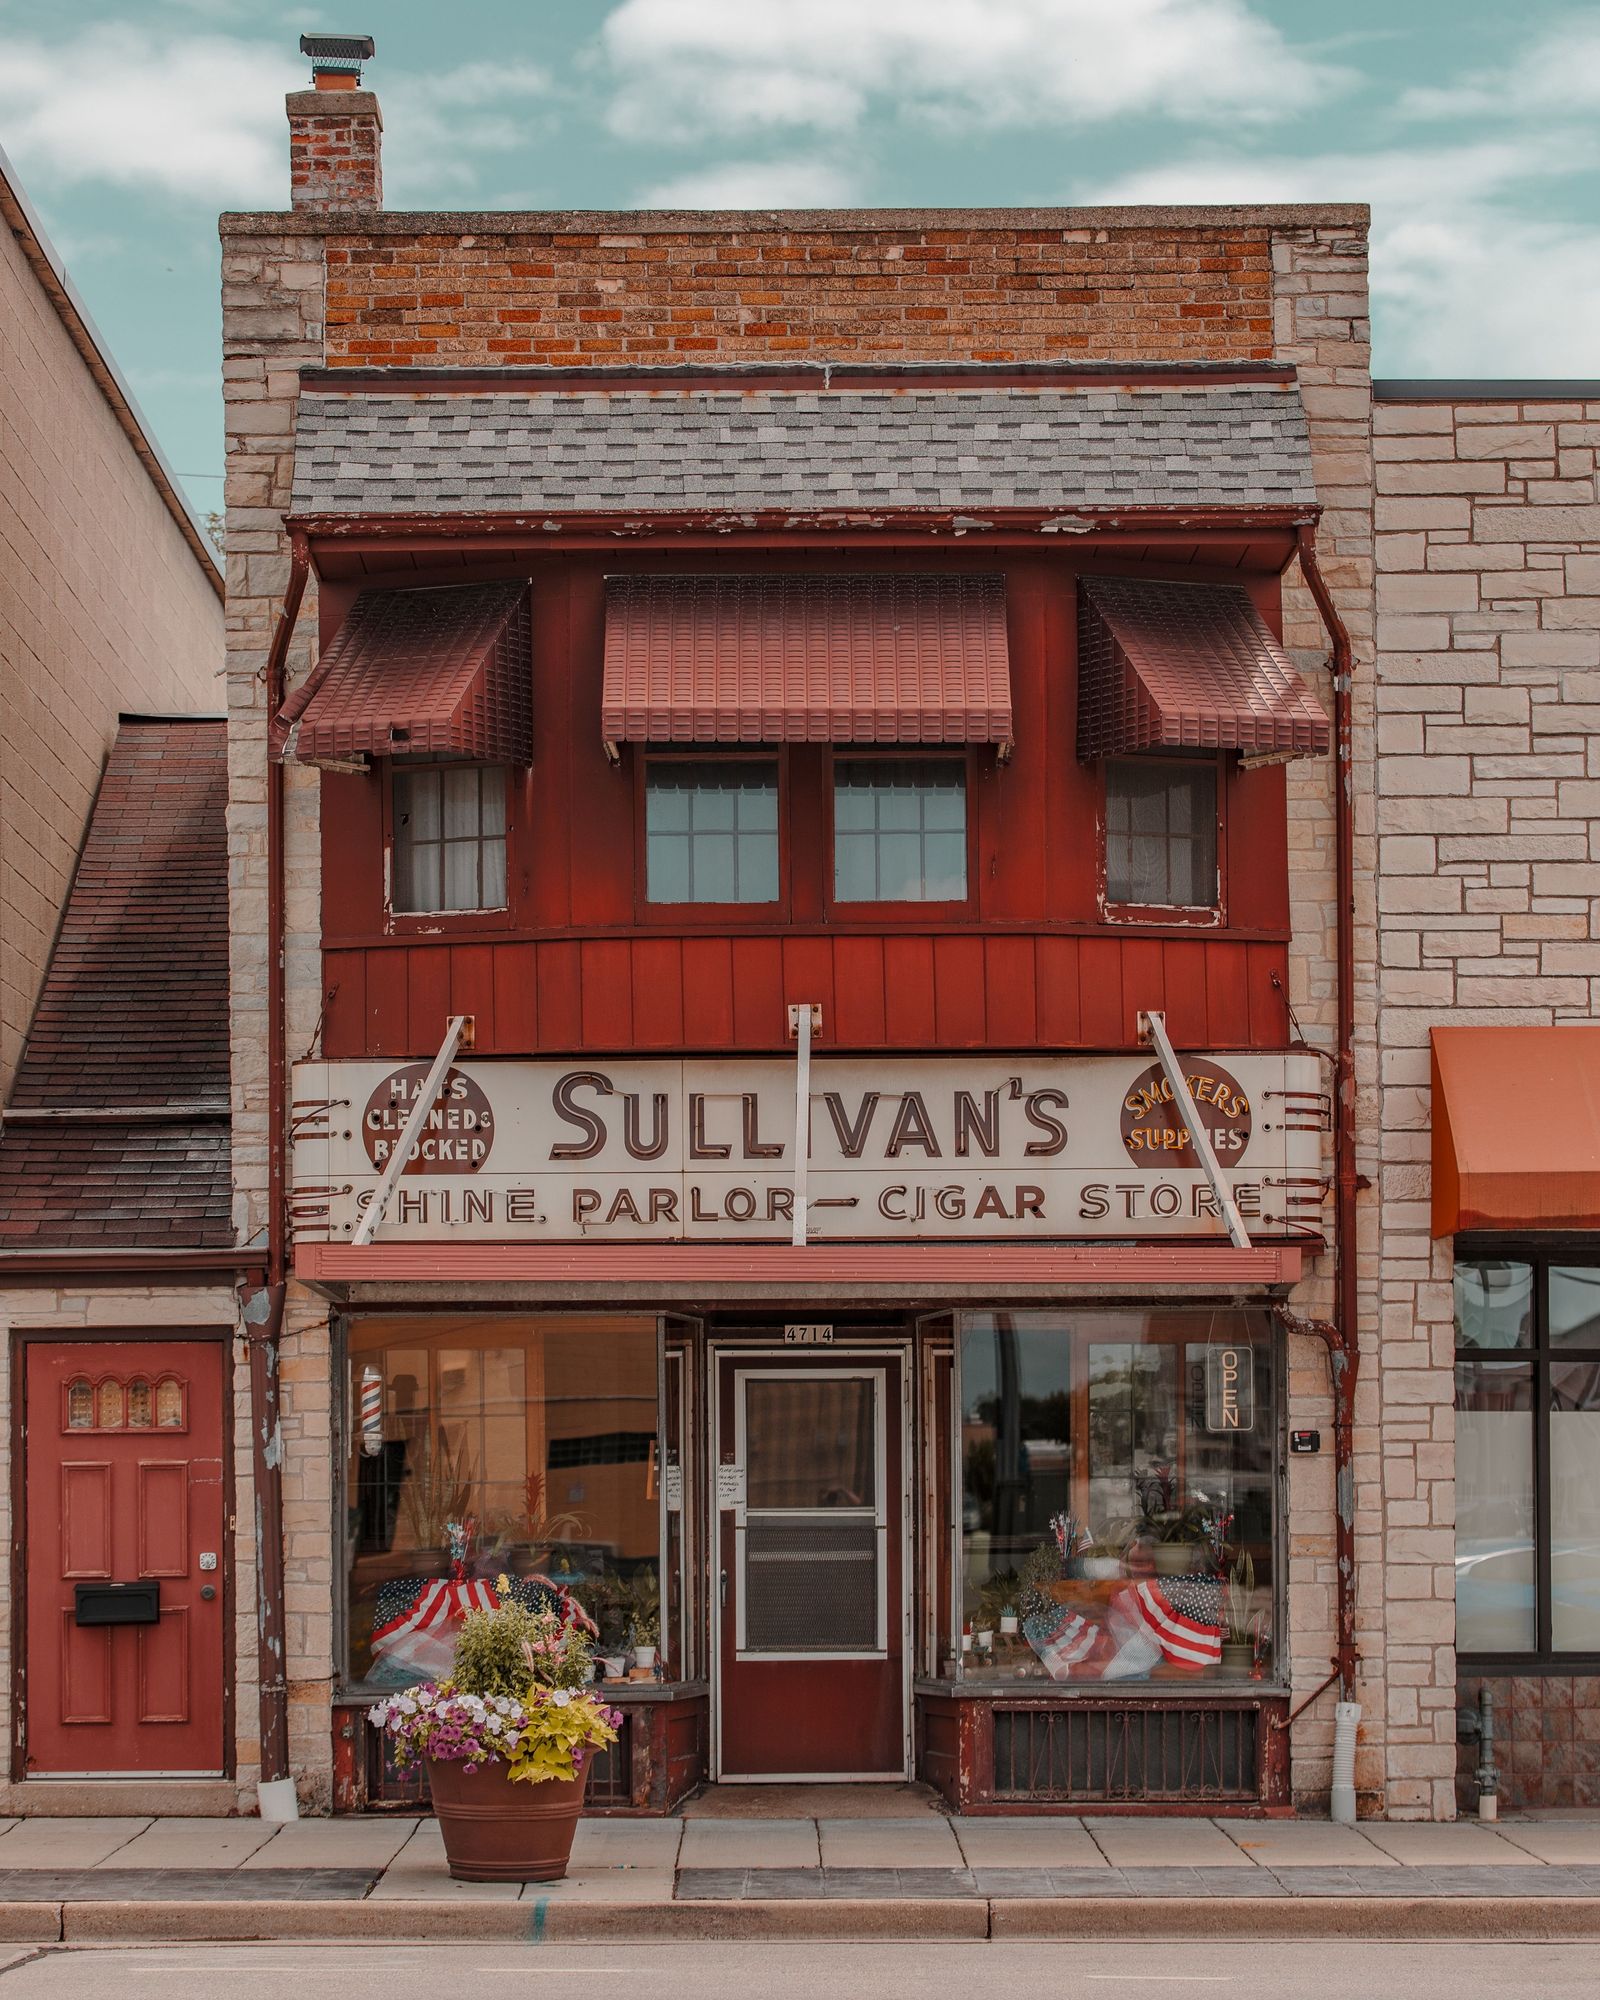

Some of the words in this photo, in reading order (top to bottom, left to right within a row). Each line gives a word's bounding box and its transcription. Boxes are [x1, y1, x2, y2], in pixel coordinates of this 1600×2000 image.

[548, 1071, 1069, 1161] SULLVAN'S
[573, 1187, 795, 1223] PARLOR
[878, 1185, 1047, 1220] CIGAR
[1079, 1184, 1261, 1219] STORE
[786, 1327, 831, 1341] 4714
[1222, 1351, 1238, 1428] OPEN
